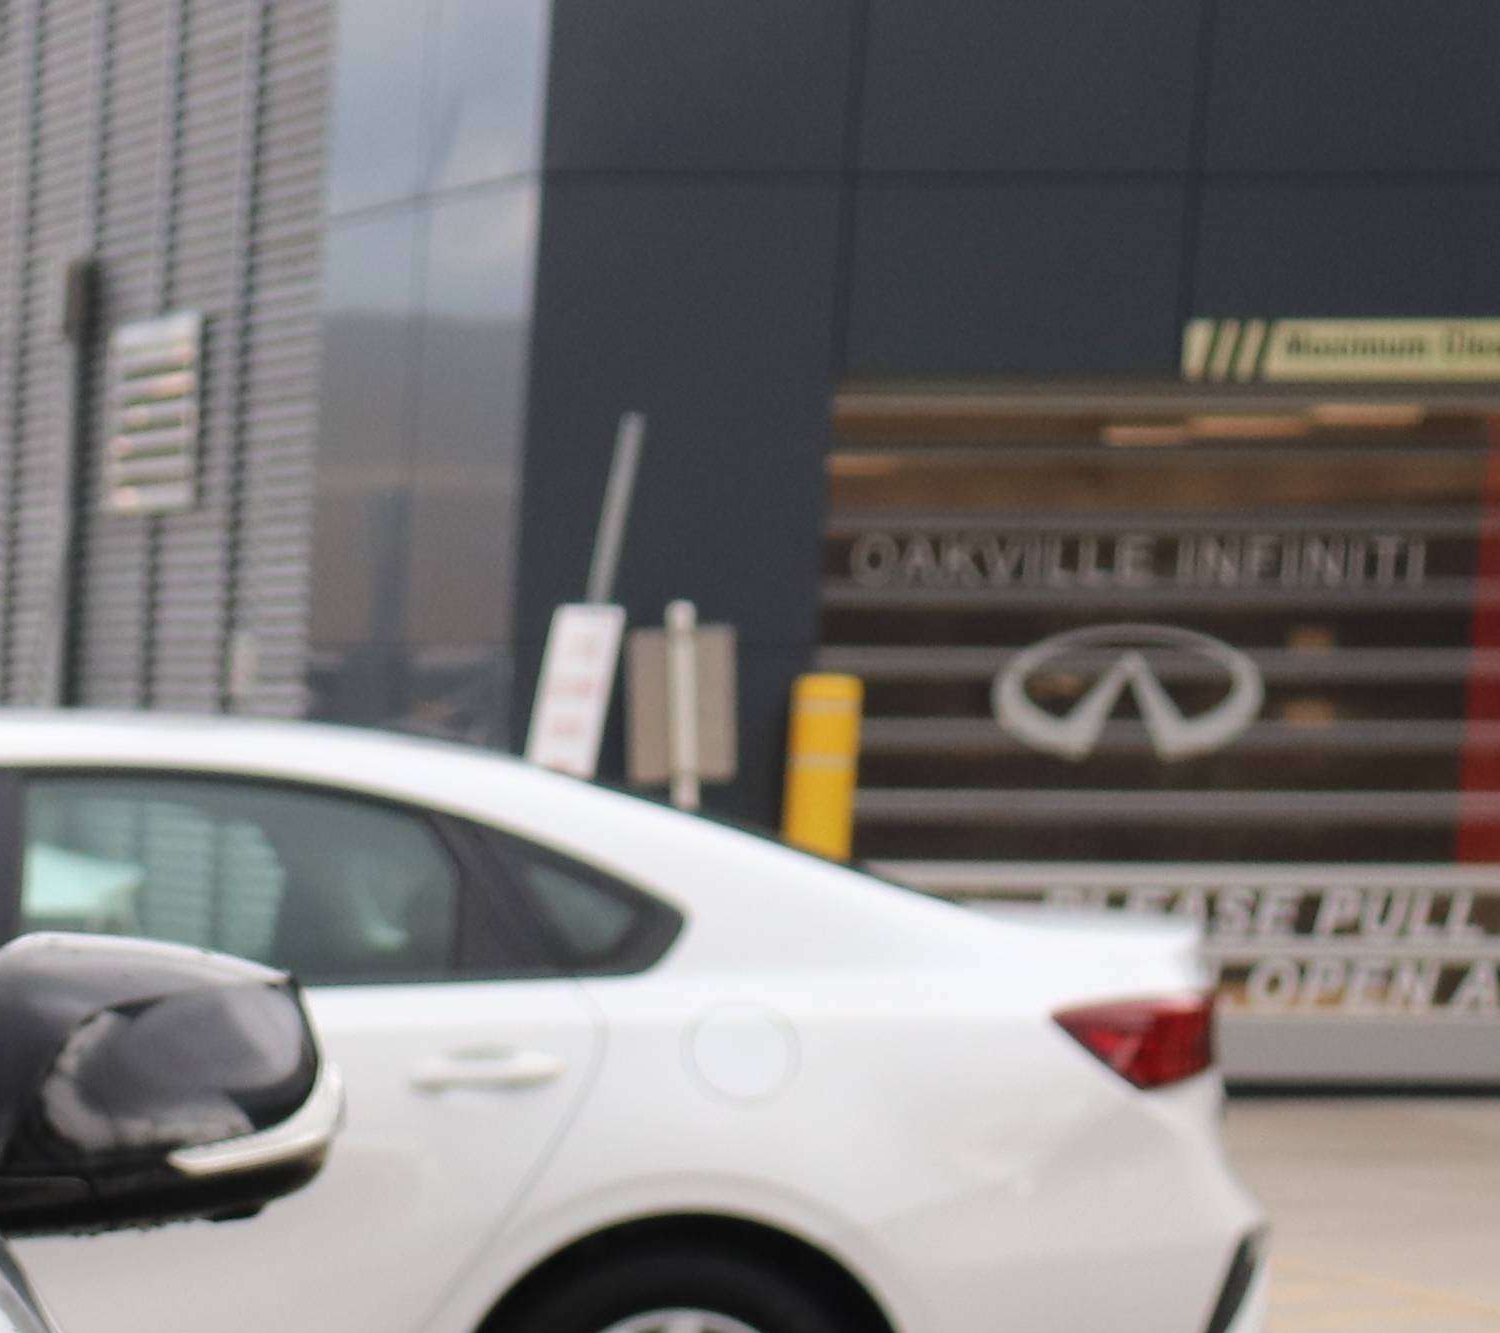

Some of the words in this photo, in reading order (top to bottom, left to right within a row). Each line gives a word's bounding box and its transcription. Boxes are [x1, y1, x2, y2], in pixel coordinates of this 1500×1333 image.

[850, 532, 1154, 588] OAKVILLE
[1177, 531, 1425, 587] INFINITI
[1312, 886, 1485, 938] PULL
[1244, 958, 1440, 1009] OPEN
